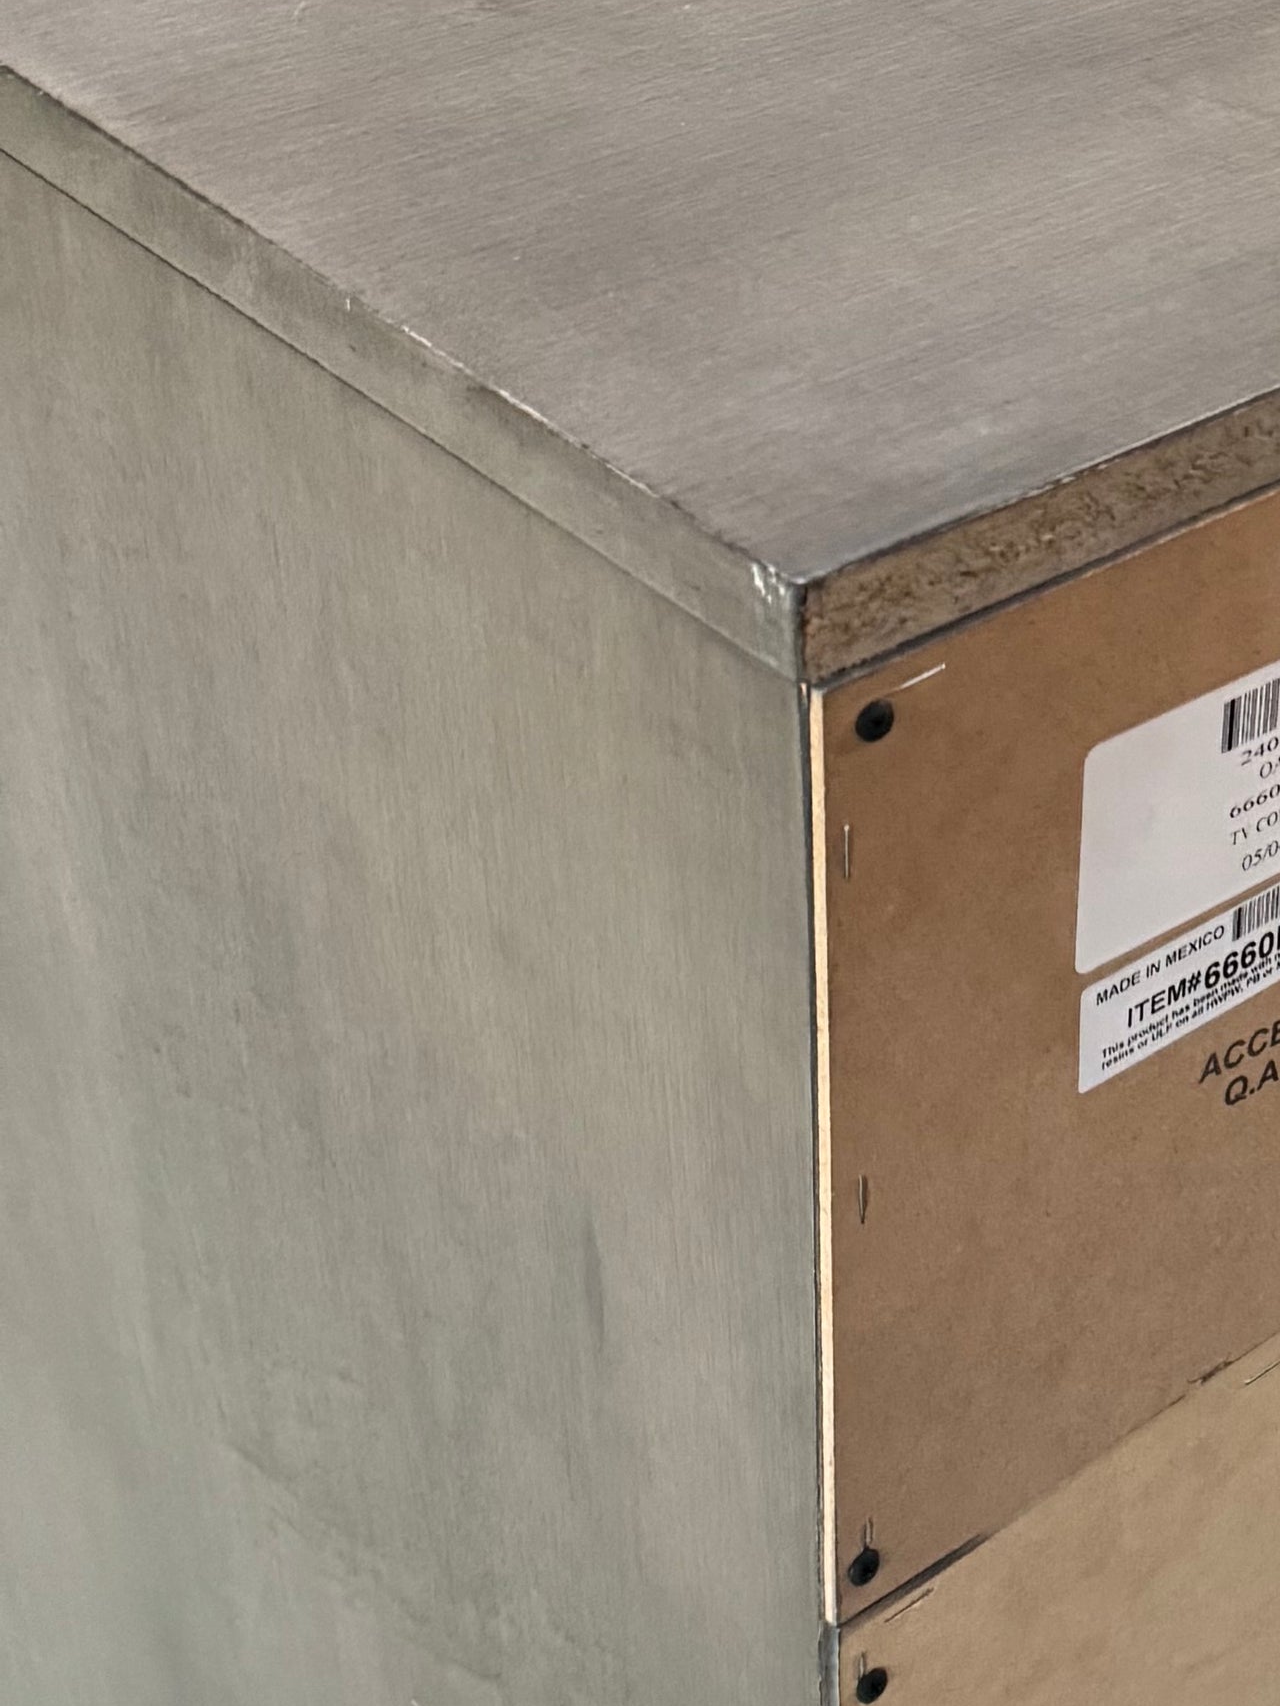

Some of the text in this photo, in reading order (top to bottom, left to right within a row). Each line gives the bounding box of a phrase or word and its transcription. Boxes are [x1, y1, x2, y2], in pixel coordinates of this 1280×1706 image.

[1230, 823, 1250, 847] TV
[1097, 925, 1224, 1006] MADE IN MEXICO
[1103, 1038, 1123, 1059] This
[1128, 1013, 1168, 1046] product
[1172, 1005, 1189, 1019] has
[1193, 988, 1217, 1007] been
[1220, 971, 1248, 992] made
[1251, 954, 1271, 975] with
[1102, 1044, 1134, 1070] resins
